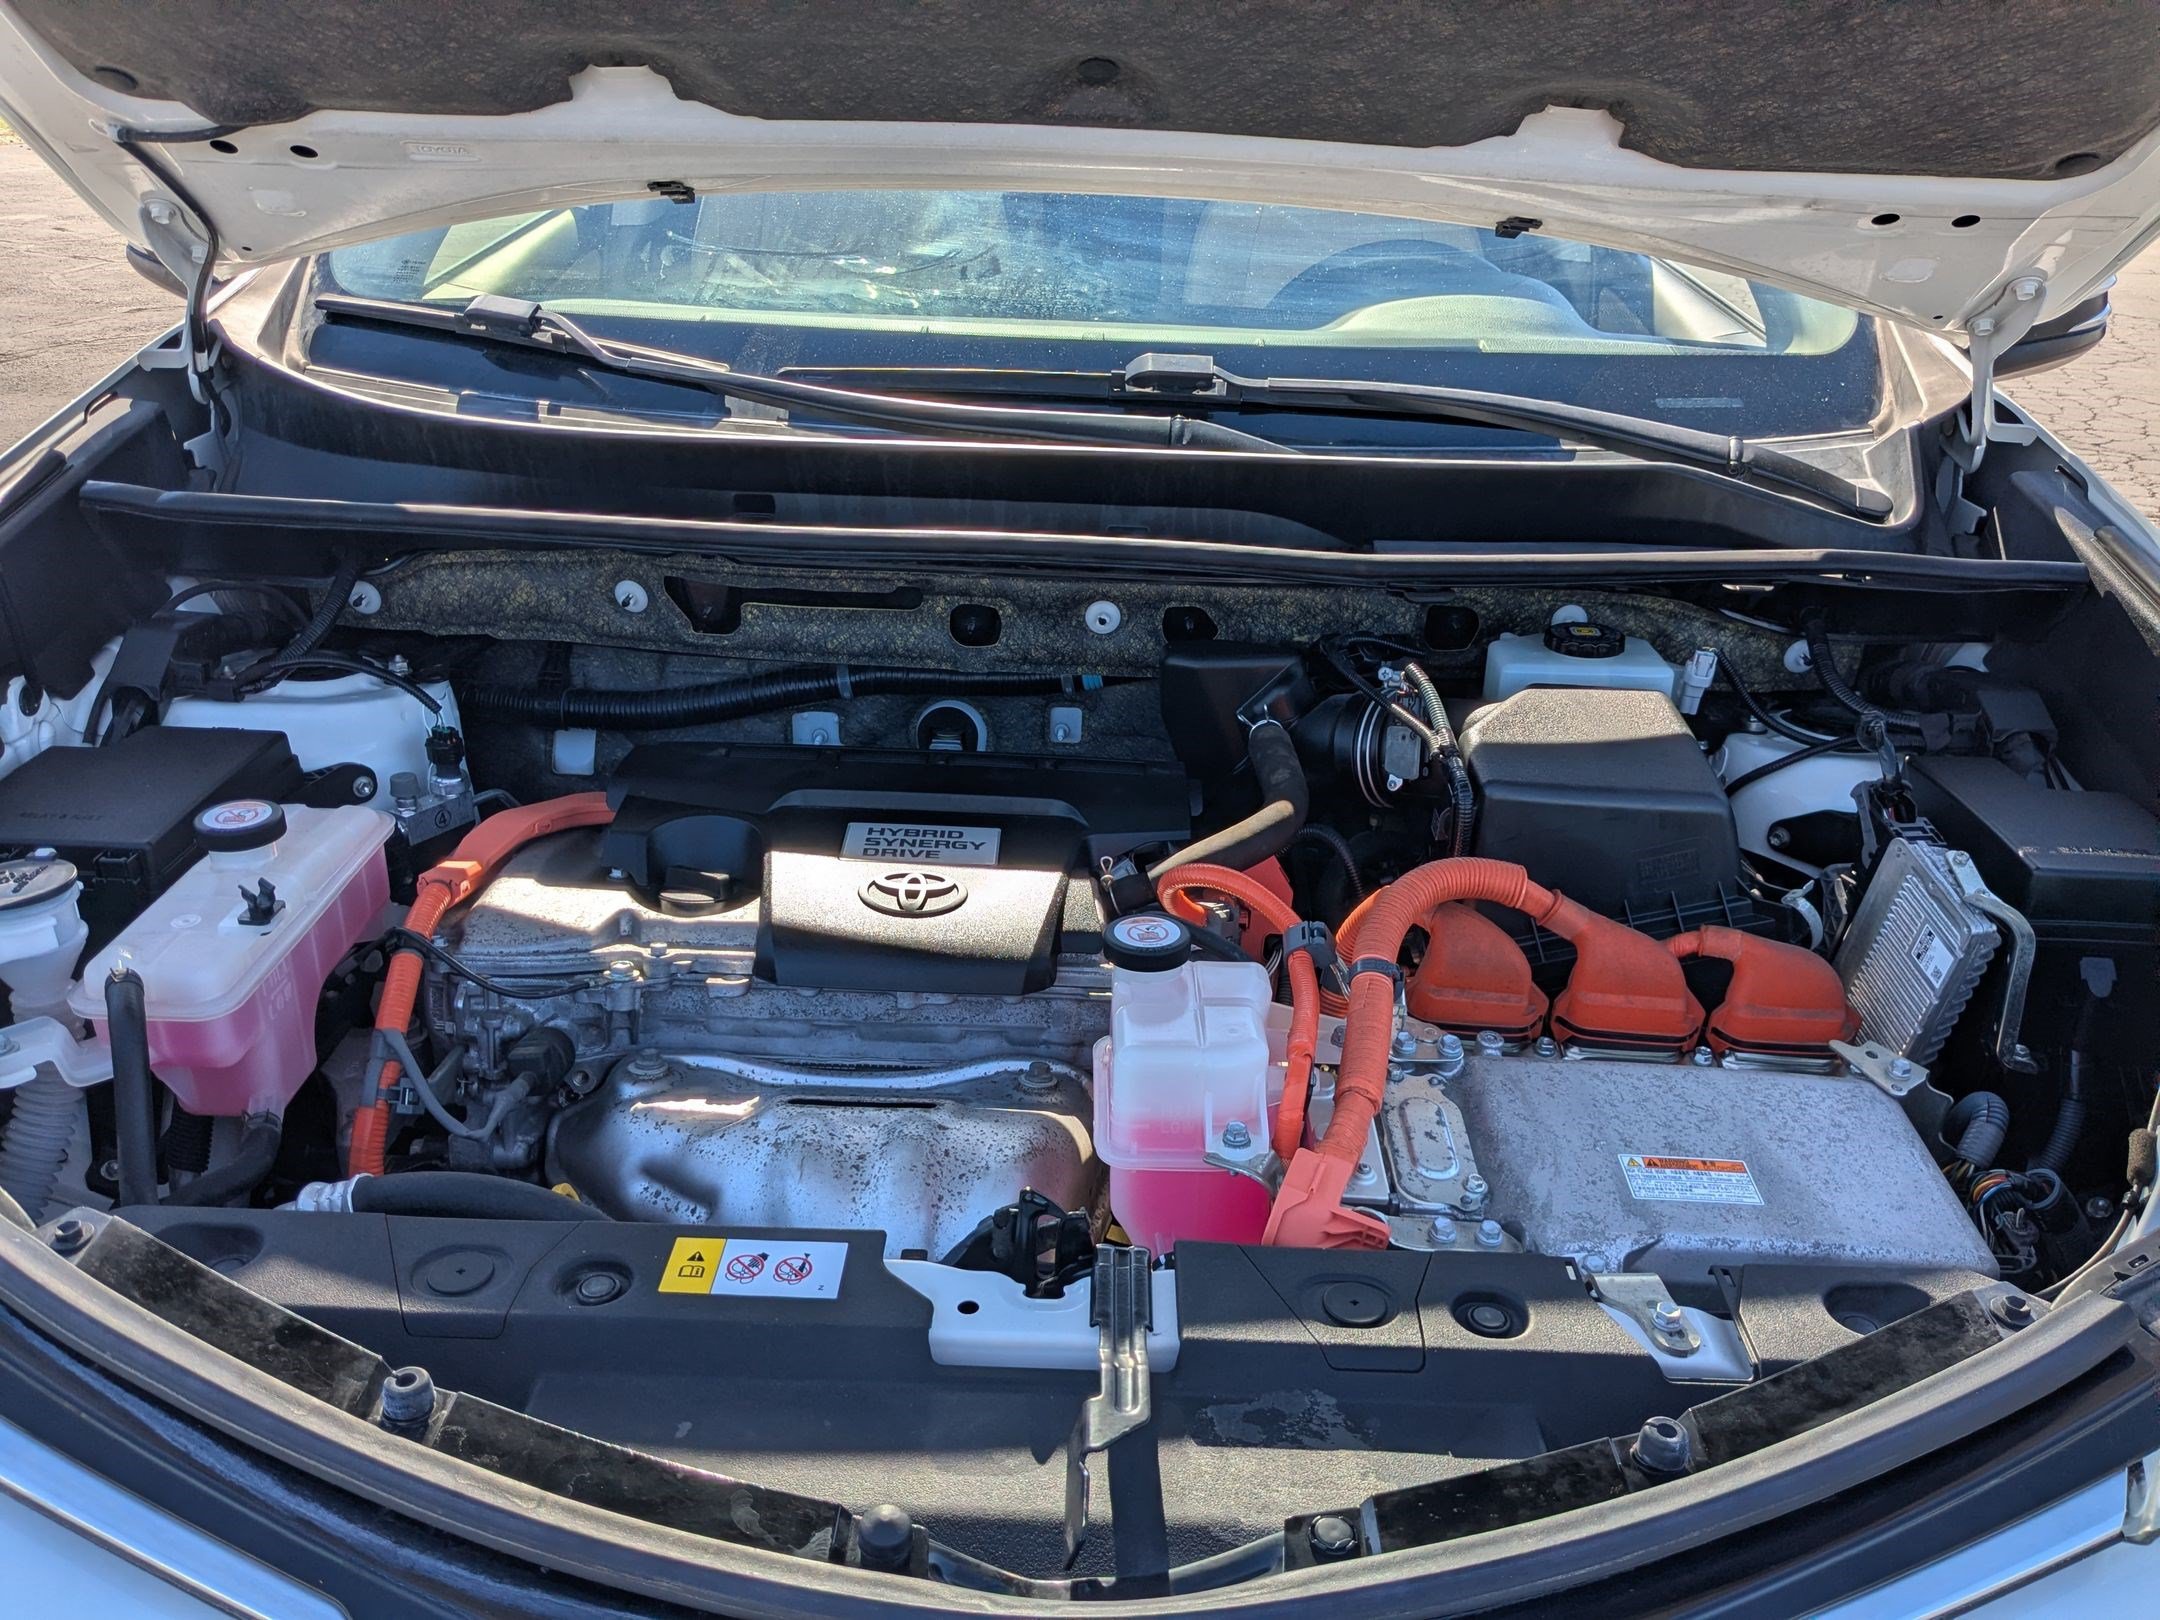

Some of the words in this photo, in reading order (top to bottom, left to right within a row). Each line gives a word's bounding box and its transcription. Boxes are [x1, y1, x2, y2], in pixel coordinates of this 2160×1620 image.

[867, 828, 964, 838] HYBRID
[864, 838, 987, 850] SYNERGY
[862, 848, 940, 858] DRIVE
